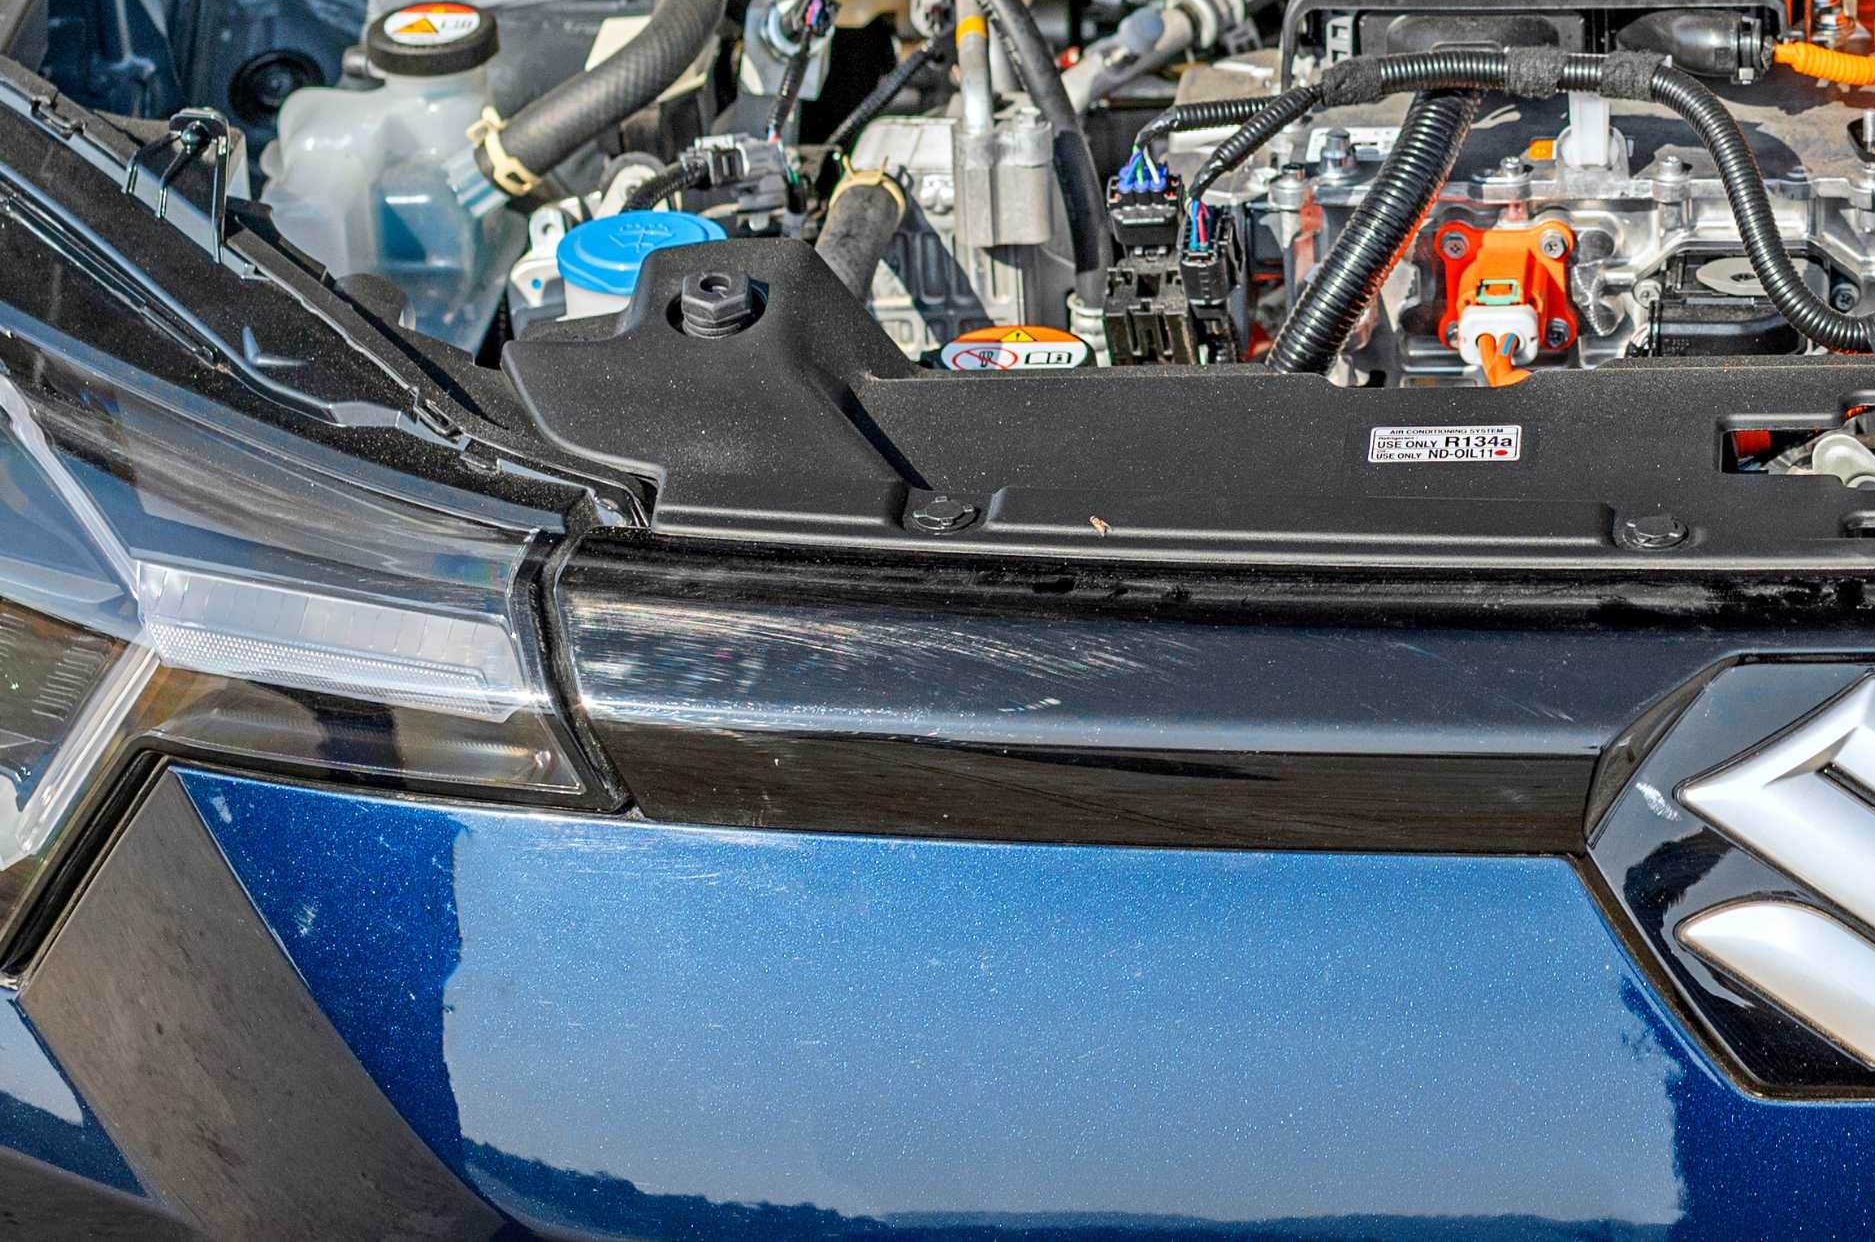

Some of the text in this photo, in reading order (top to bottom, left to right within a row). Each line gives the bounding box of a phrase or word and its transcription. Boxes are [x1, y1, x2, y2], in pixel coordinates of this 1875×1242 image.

[1377, 436, 1512, 449] USE ONLY R134a
[1428, 448, 1493, 459] ND-OIL11
